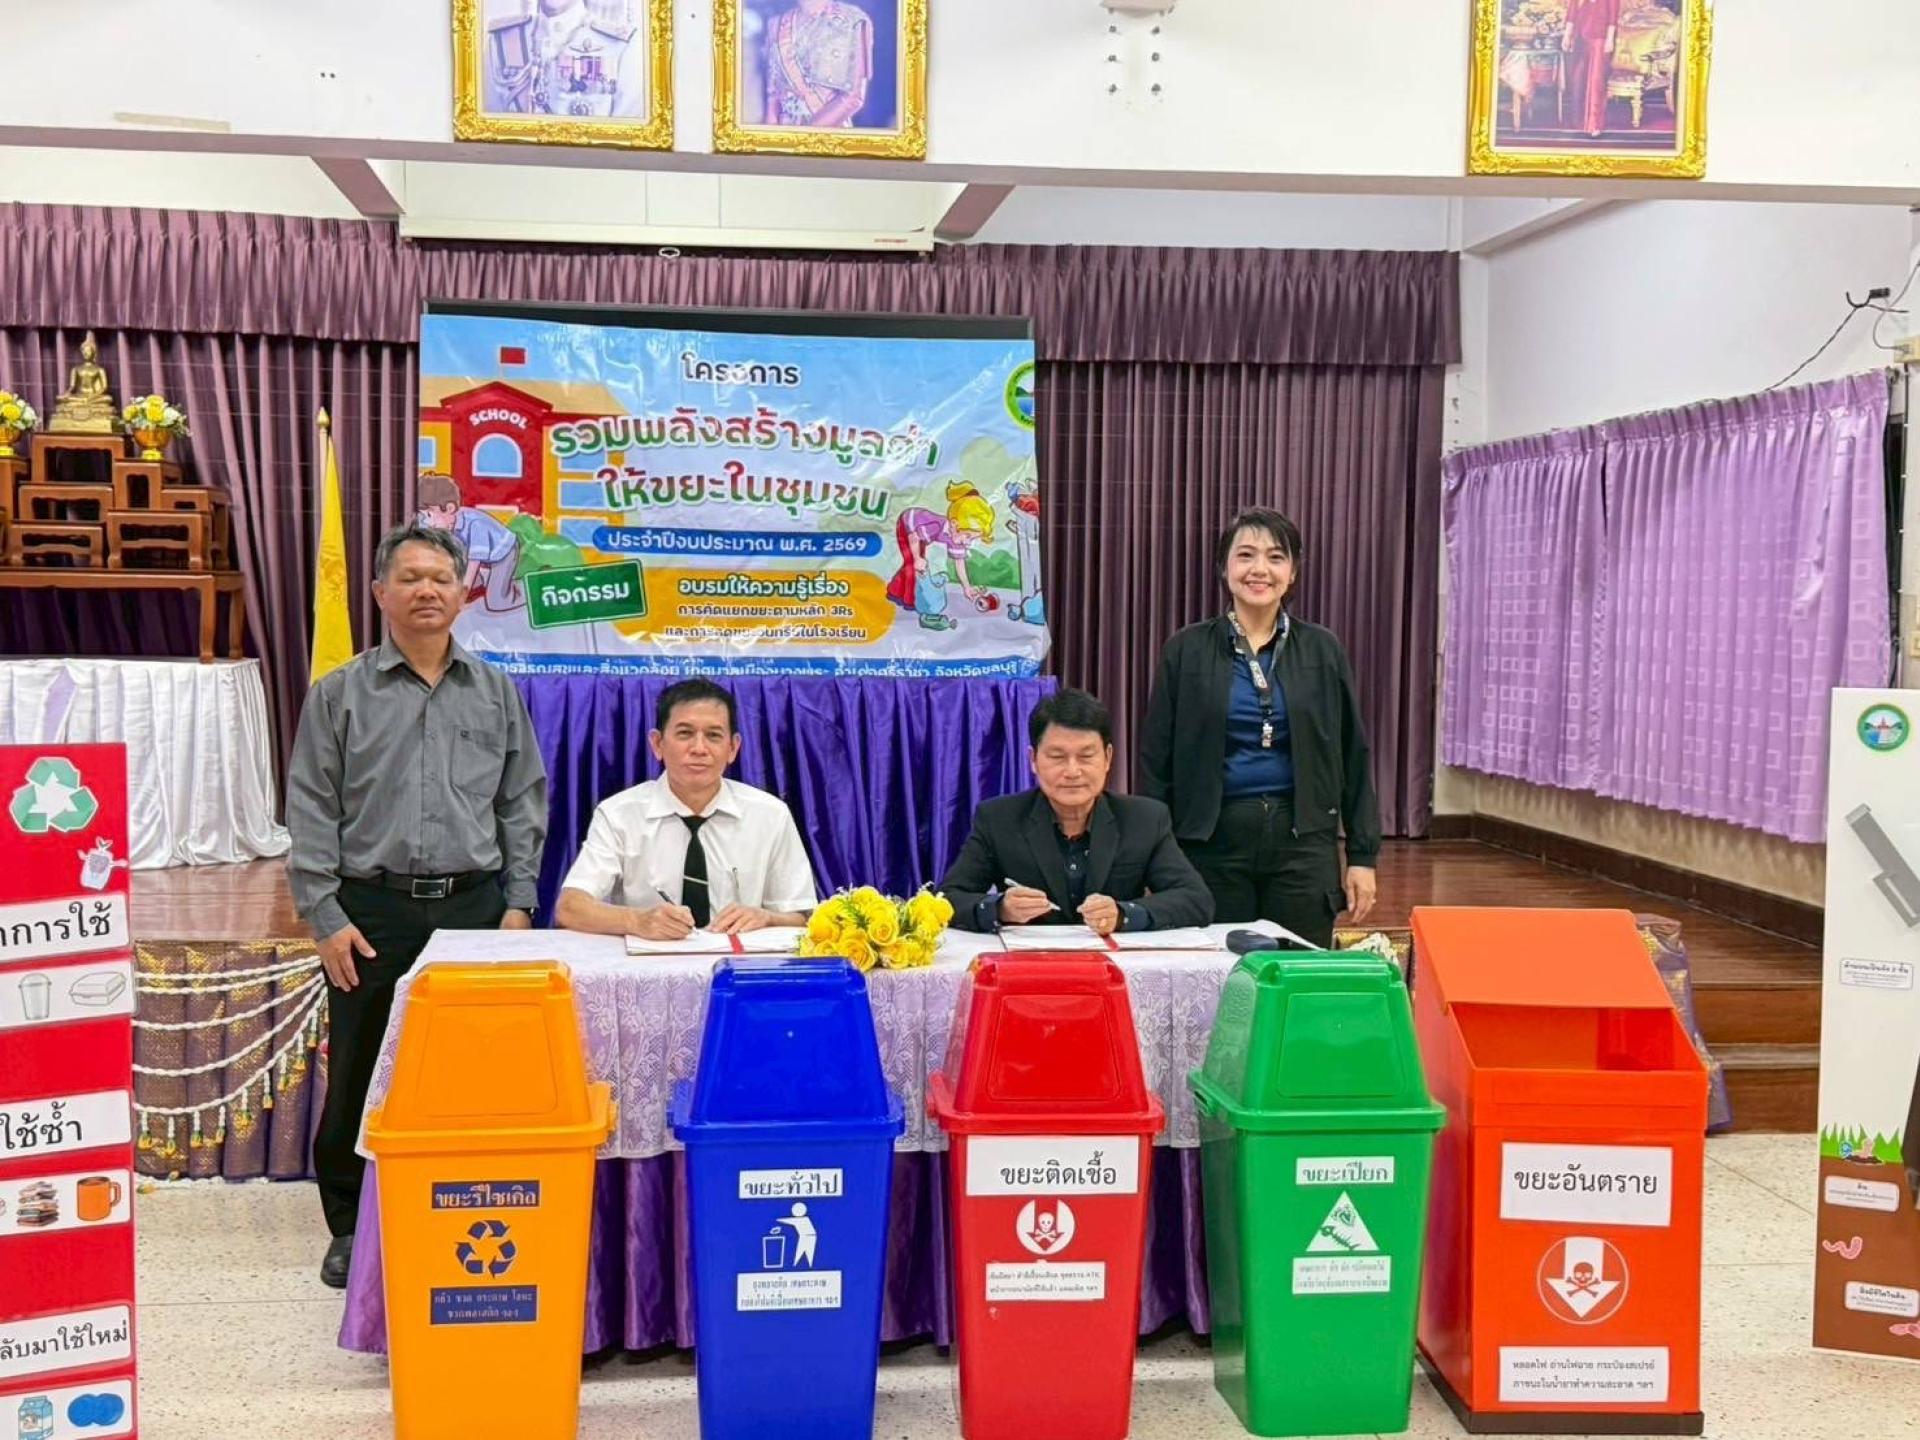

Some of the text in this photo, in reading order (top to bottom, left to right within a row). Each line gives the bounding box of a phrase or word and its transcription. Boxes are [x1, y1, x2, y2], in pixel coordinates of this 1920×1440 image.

[681, 351, 799, 384] โครงการ
[469, 409, 529, 429] SCHOOL
[552, 407, 938, 466] รวมพลังสร้างมูลค่า
[598, 462, 888, 519] ให้ขยะในชุมชน
[608, 531, 867, 553] ประจำปีงบประมาณ พ.ศ. 2569
[541, 580, 630, 607] กิจกรรม
[678, 572, 849, 600] อบรมให้ความรู้เรื่อง
[678, 602, 854, 617] การคัดแยกขยะตามหลัก 3Rs
[0, 1101, 83, 1150] ใช้ซ้ำ
[1000, 1151, 1118, 1185] ขยะติดเชื้อ
[1302, 1161, 1388, 1182] ขยะเปียก
[1514, 1163, 1657, 1194] ขยะอันตราย
[744, 1170, 838, 1196] ขยะทั่วไป
